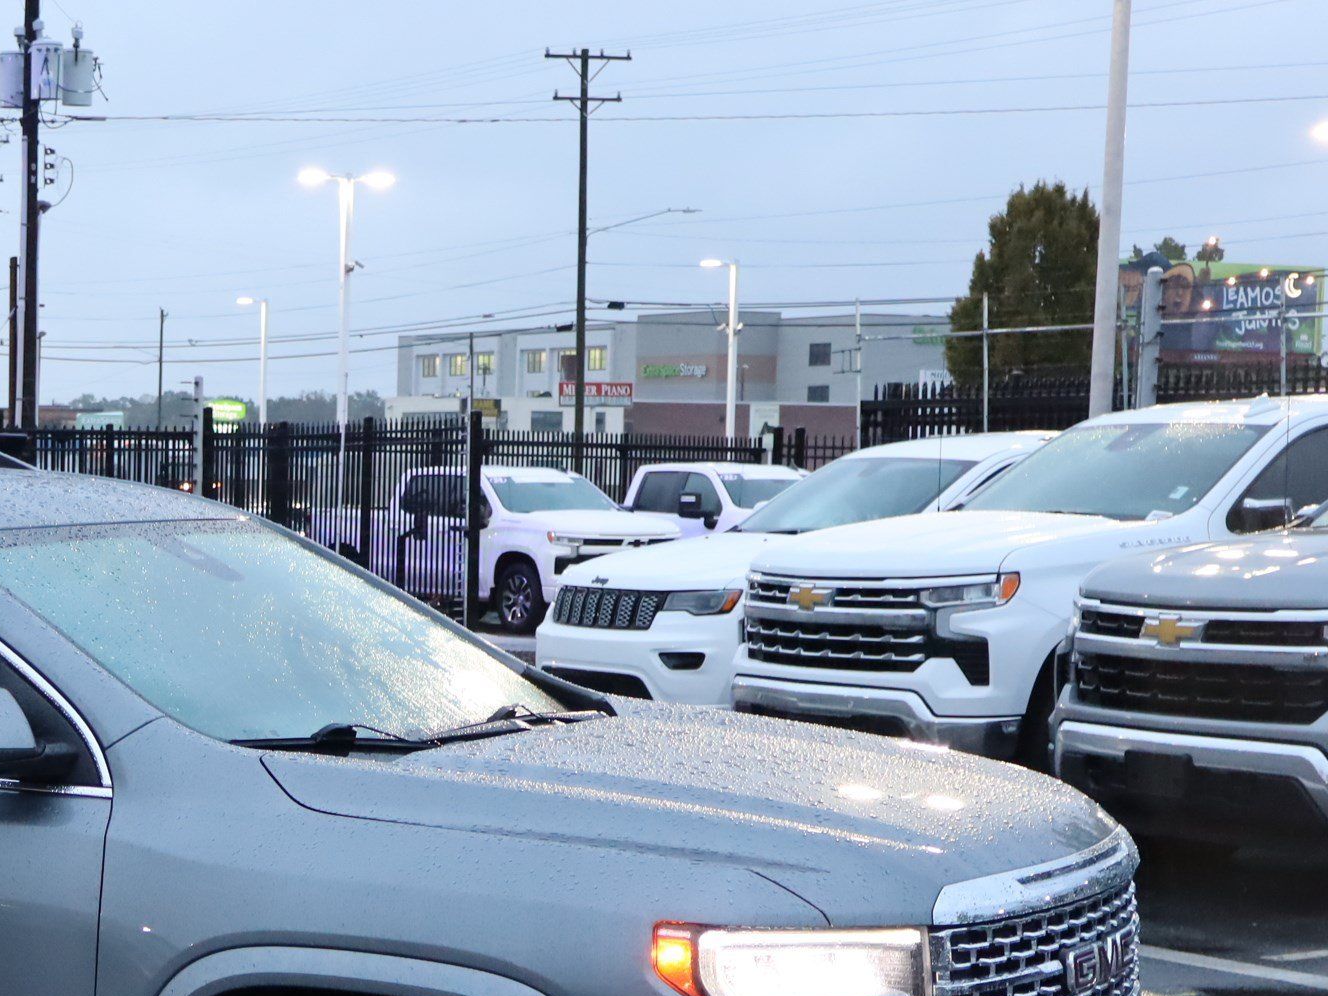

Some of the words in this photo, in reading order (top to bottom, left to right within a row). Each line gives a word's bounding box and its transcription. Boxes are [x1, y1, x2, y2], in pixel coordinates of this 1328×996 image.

[563, 384, 597, 396] MIER
[601, 384, 631, 396] PIANO
[1067, 920, 1136, 993] GMC
